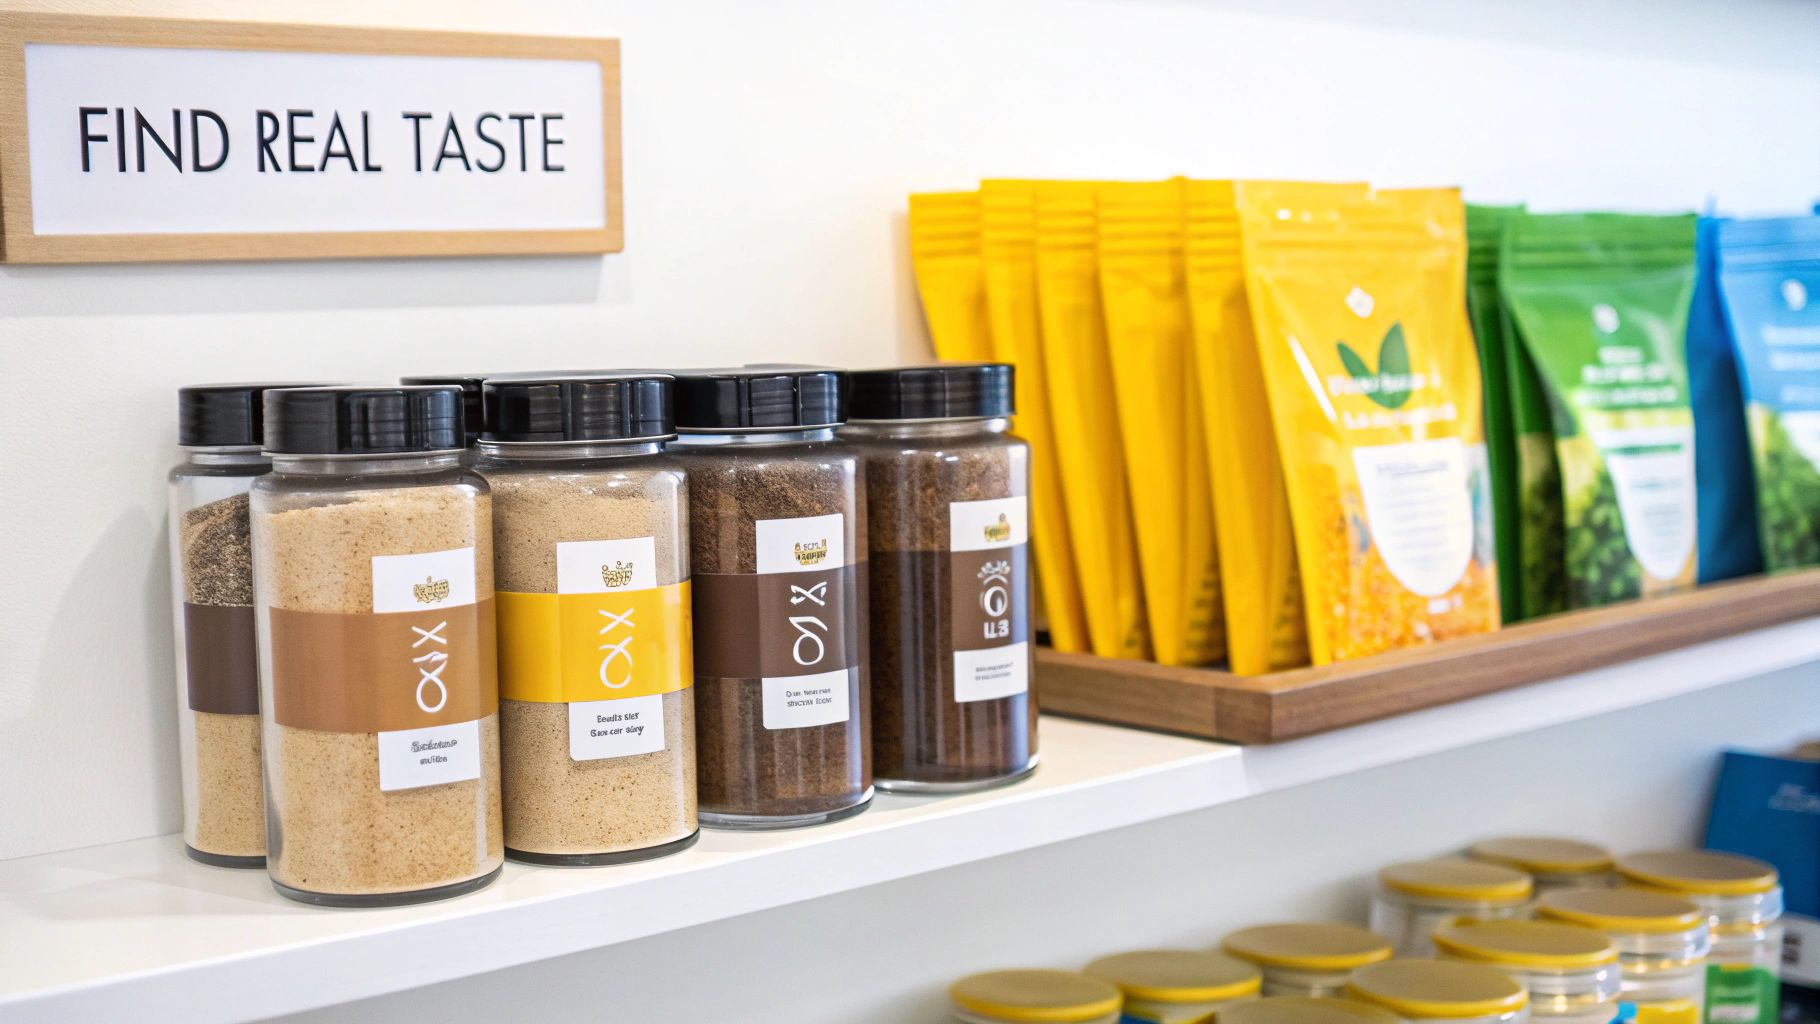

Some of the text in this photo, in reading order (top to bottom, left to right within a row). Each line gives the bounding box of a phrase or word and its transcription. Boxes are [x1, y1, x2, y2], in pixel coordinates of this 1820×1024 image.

[79, 106, 566, 174] FIND REAL TASTE
